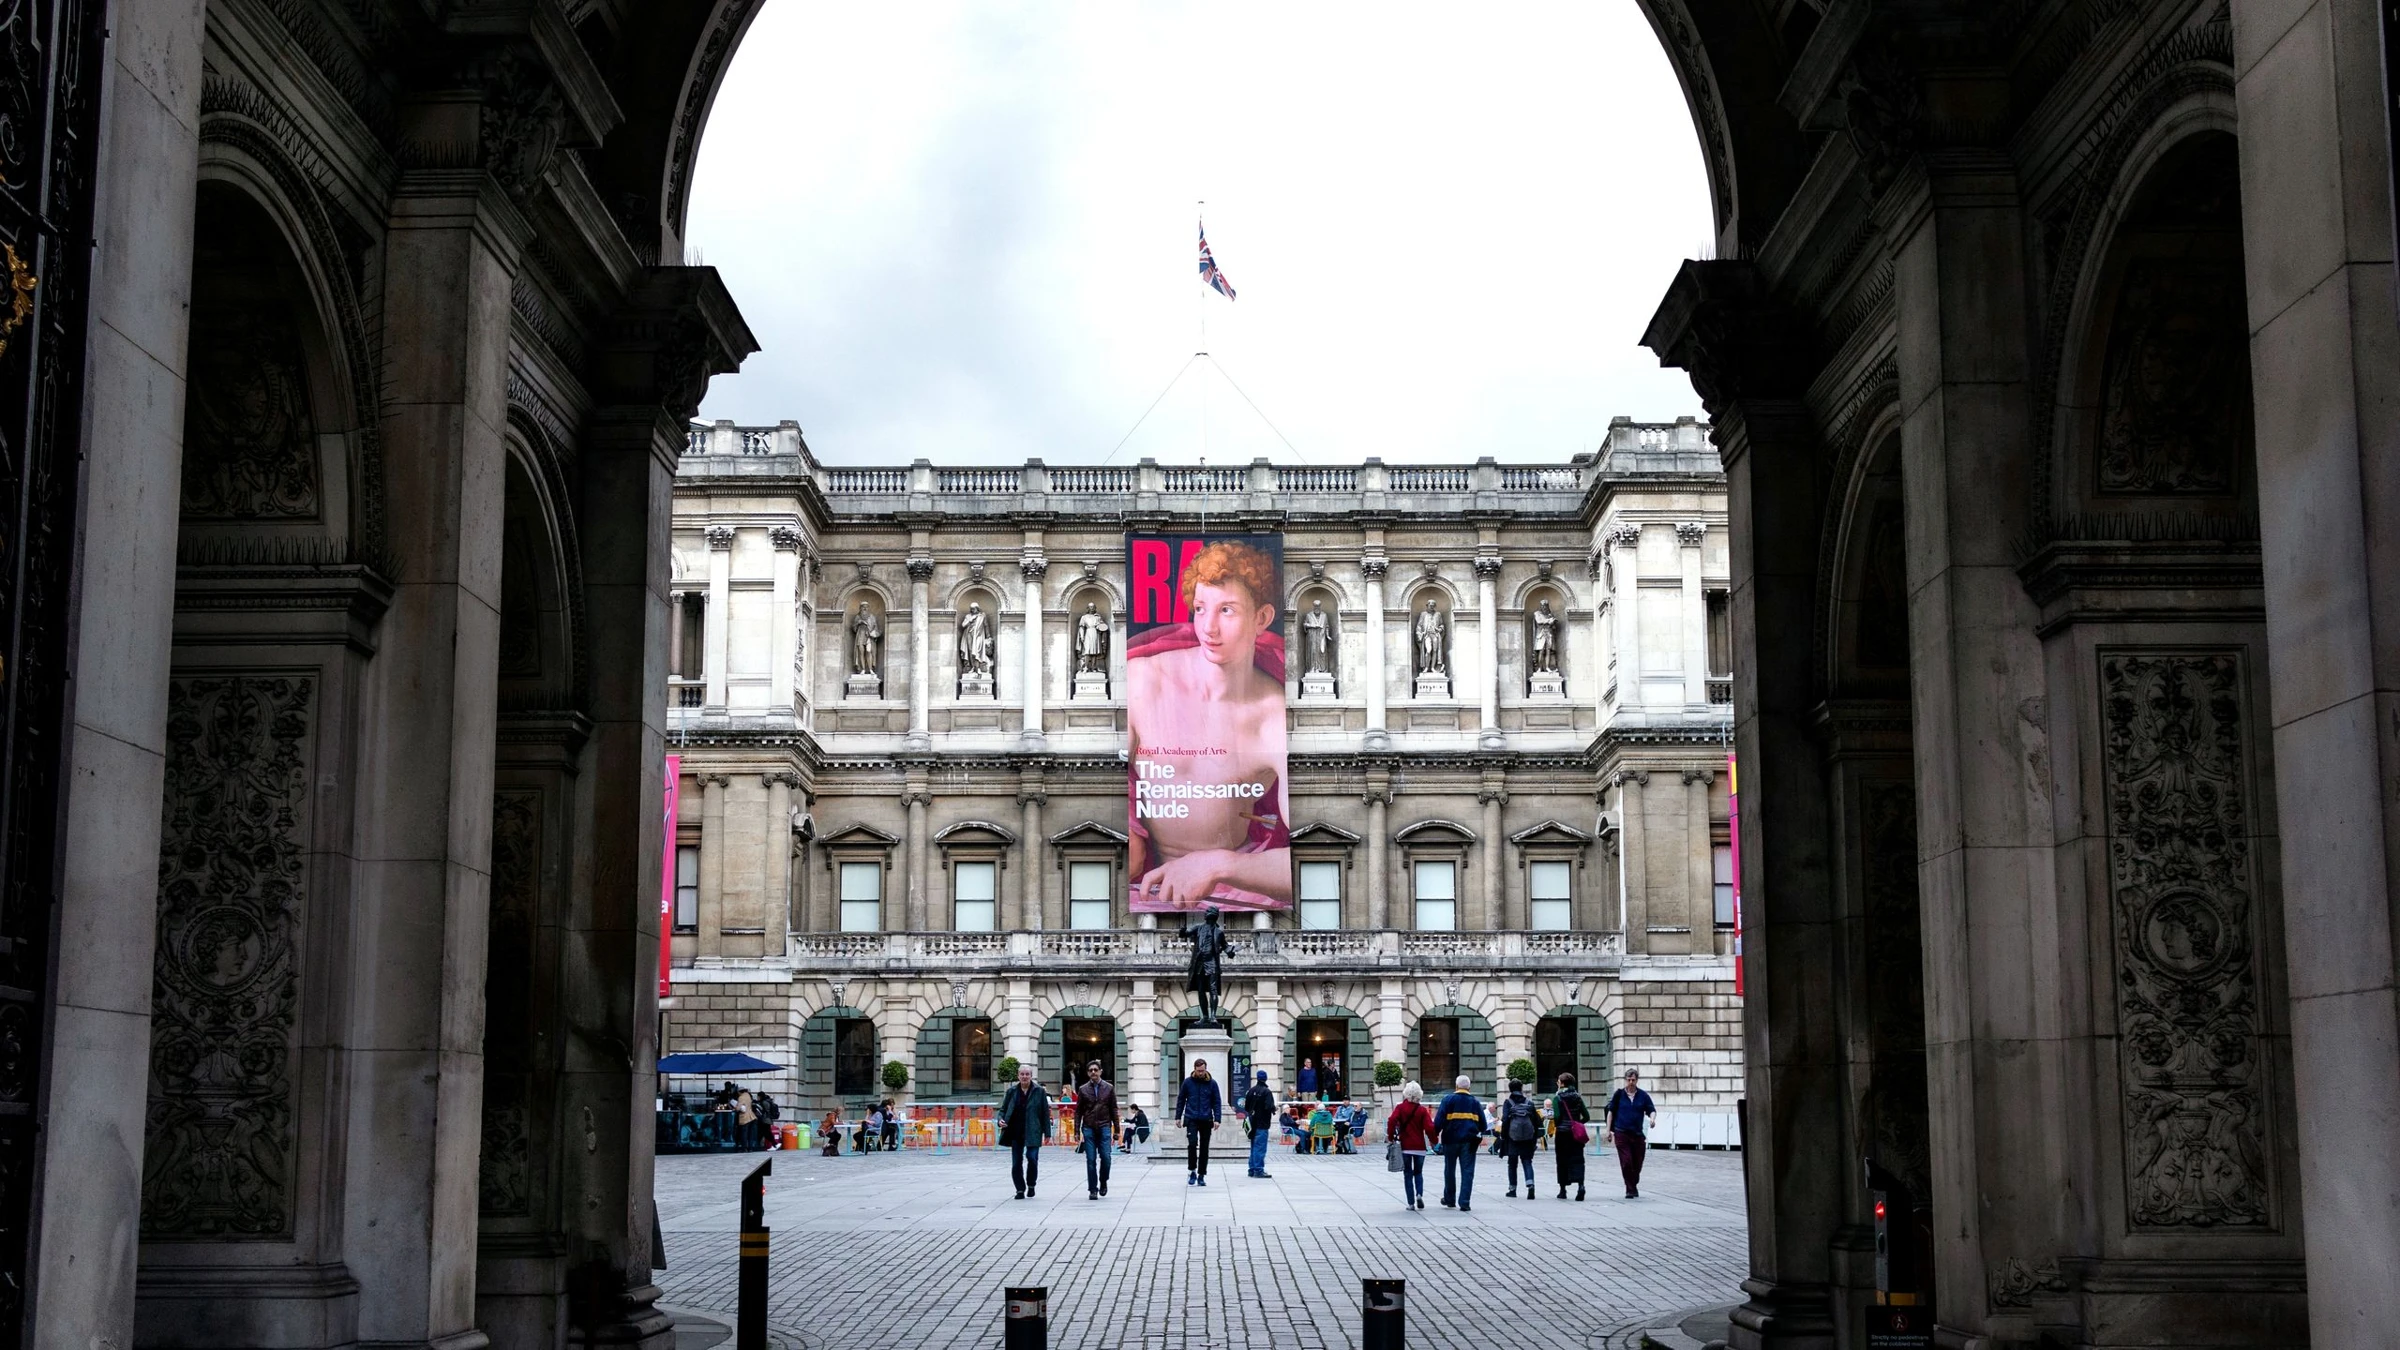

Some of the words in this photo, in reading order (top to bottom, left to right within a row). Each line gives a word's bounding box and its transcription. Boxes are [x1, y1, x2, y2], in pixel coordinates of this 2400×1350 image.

[1136, 746, 1159, 757] Royal
[1160, 747, 1198, 757] Academy
[1199, 747, 1208, 755] of
[1209, 747, 1227, 755] Arts
[1135, 760, 1175, 779] The
[1135, 780, 1265, 799] Renaissance
[1135, 800, 1189, 818] Nude
